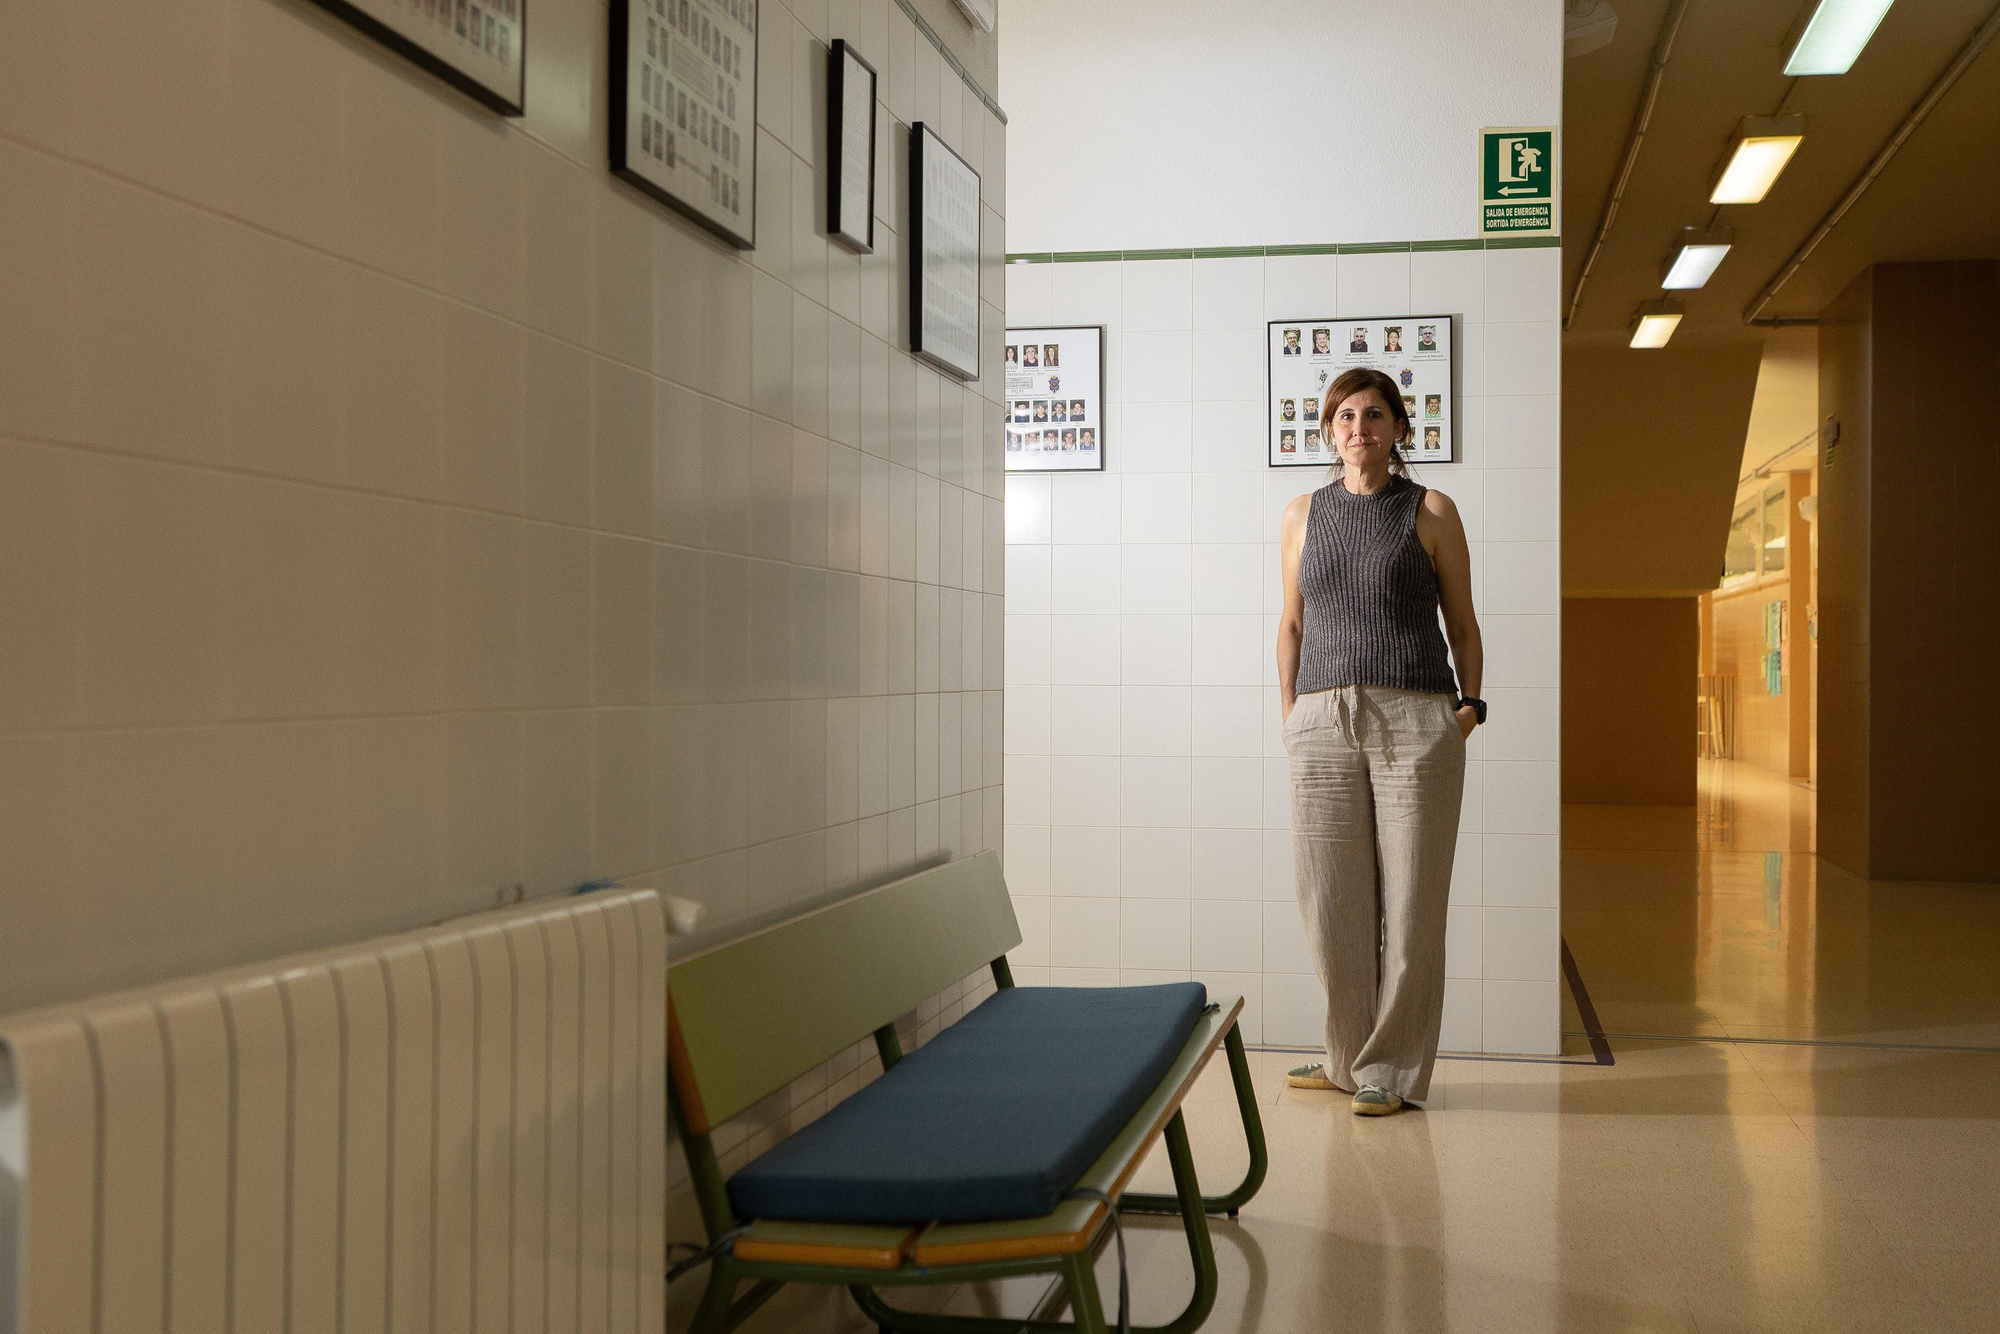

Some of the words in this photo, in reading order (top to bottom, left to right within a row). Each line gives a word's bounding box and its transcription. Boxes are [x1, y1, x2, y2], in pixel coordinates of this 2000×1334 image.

[1486, 208, 1505, 217] SALIDA
[1506, 208, 1513, 217] DE
[1514, 206, 1548, 216] EMERGENCIA
[1486, 218, 1509, 228] SORTIDA
